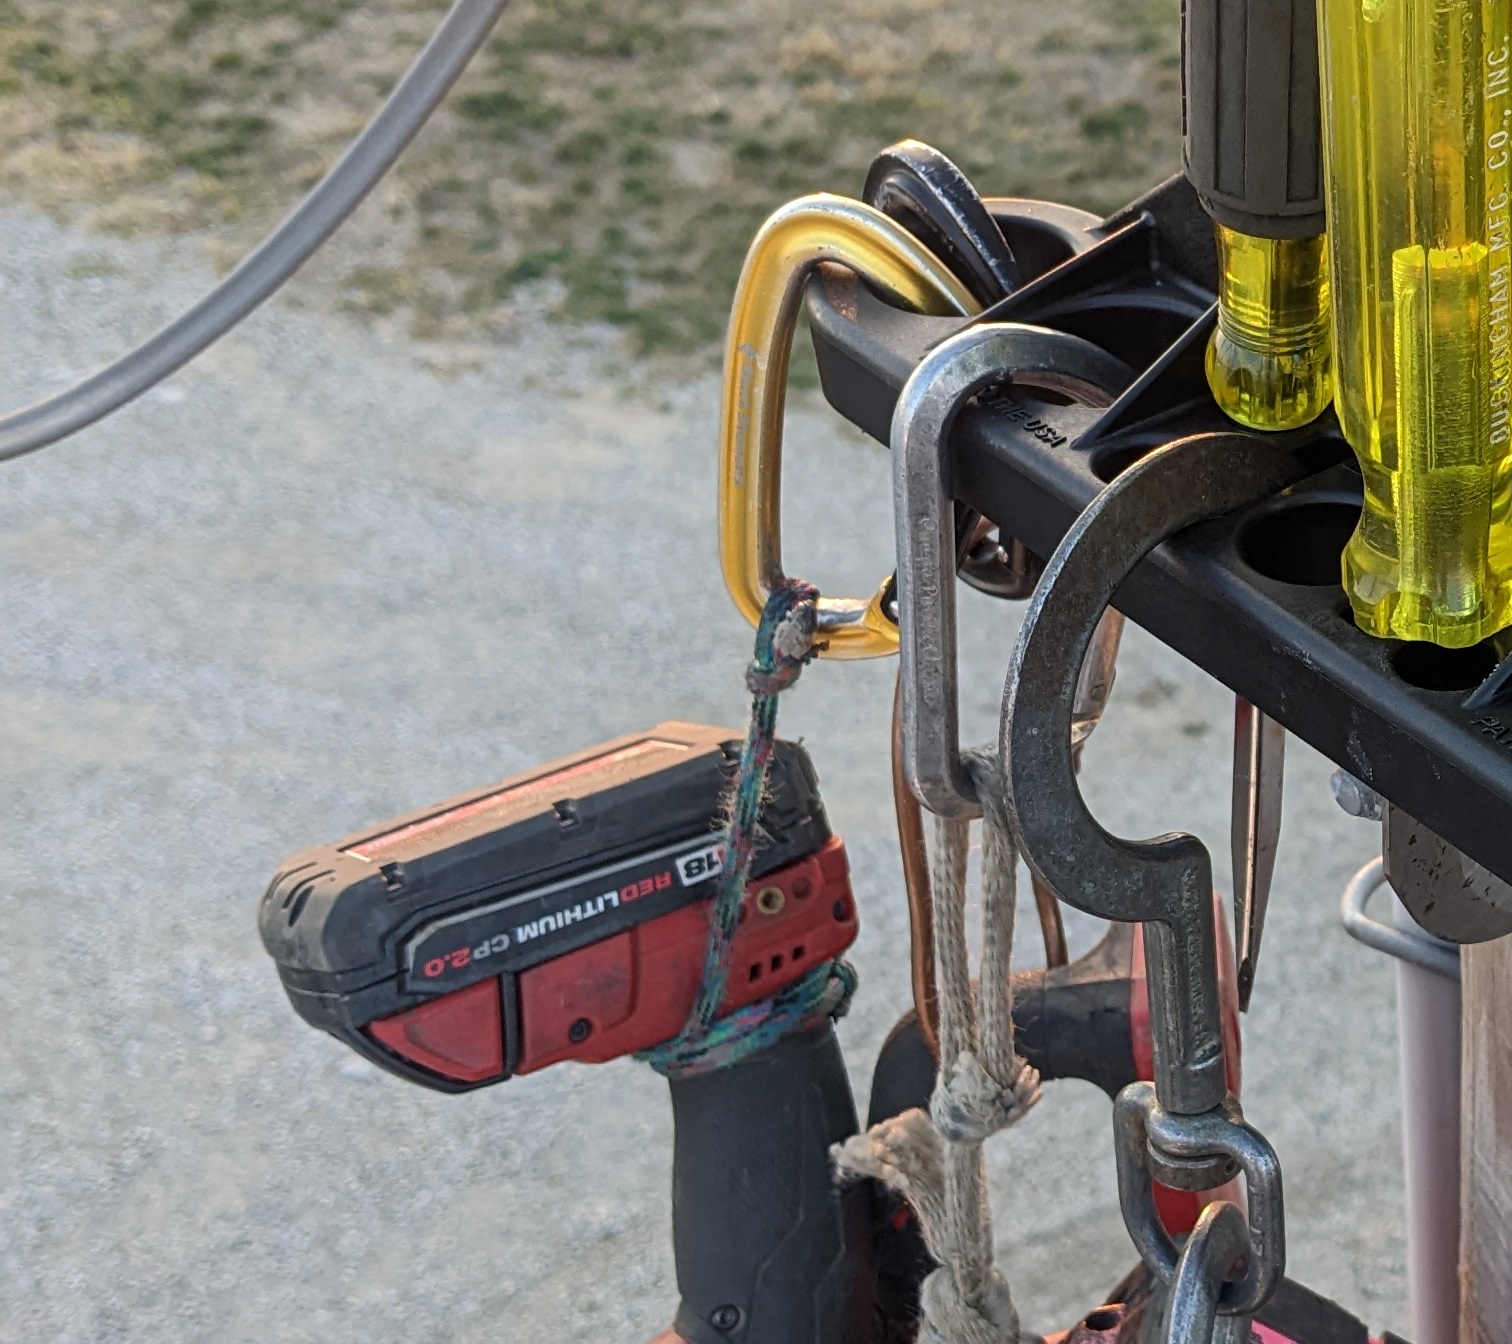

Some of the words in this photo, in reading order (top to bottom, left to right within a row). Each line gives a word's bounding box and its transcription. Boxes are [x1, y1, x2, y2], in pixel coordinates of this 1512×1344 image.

[1487, 35, 1509, 100] INC.
[1023, 419, 1067, 448] USA
[684, 849, 725, 881] 18
